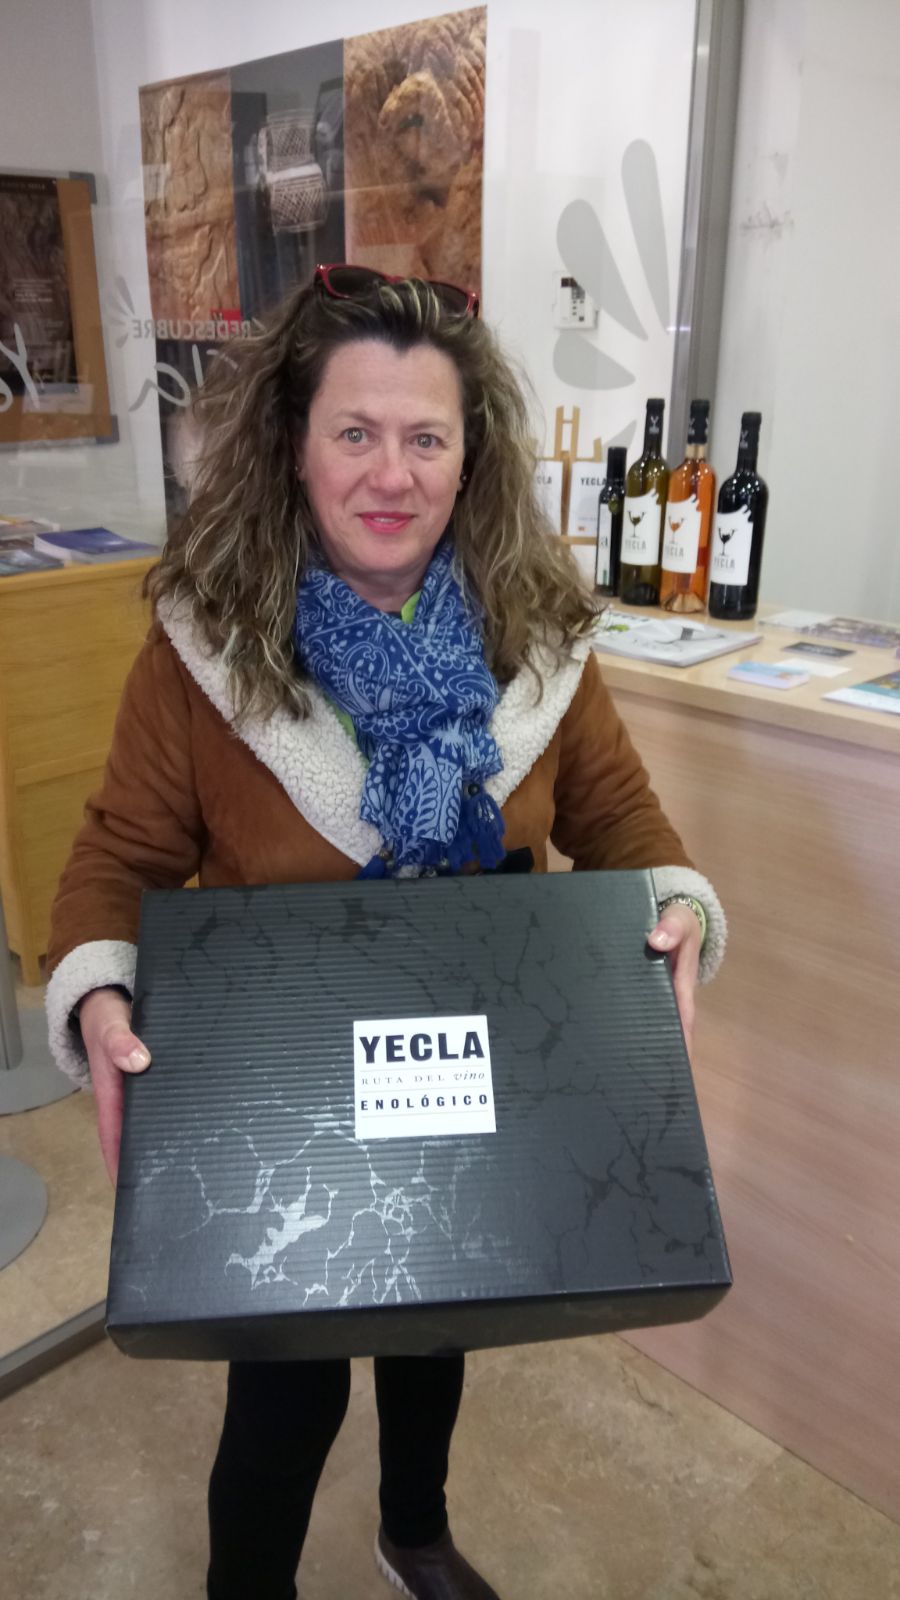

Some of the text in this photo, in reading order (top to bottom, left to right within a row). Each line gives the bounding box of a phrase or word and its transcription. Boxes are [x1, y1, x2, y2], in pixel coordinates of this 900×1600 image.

[536, 475, 552, 485] CLA
[359, 1031, 485, 1064] YECLA
[361, 1070, 485, 1085] RUTA DEL vino
[361, 1094, 488, 1111] ENOLÓGICO
